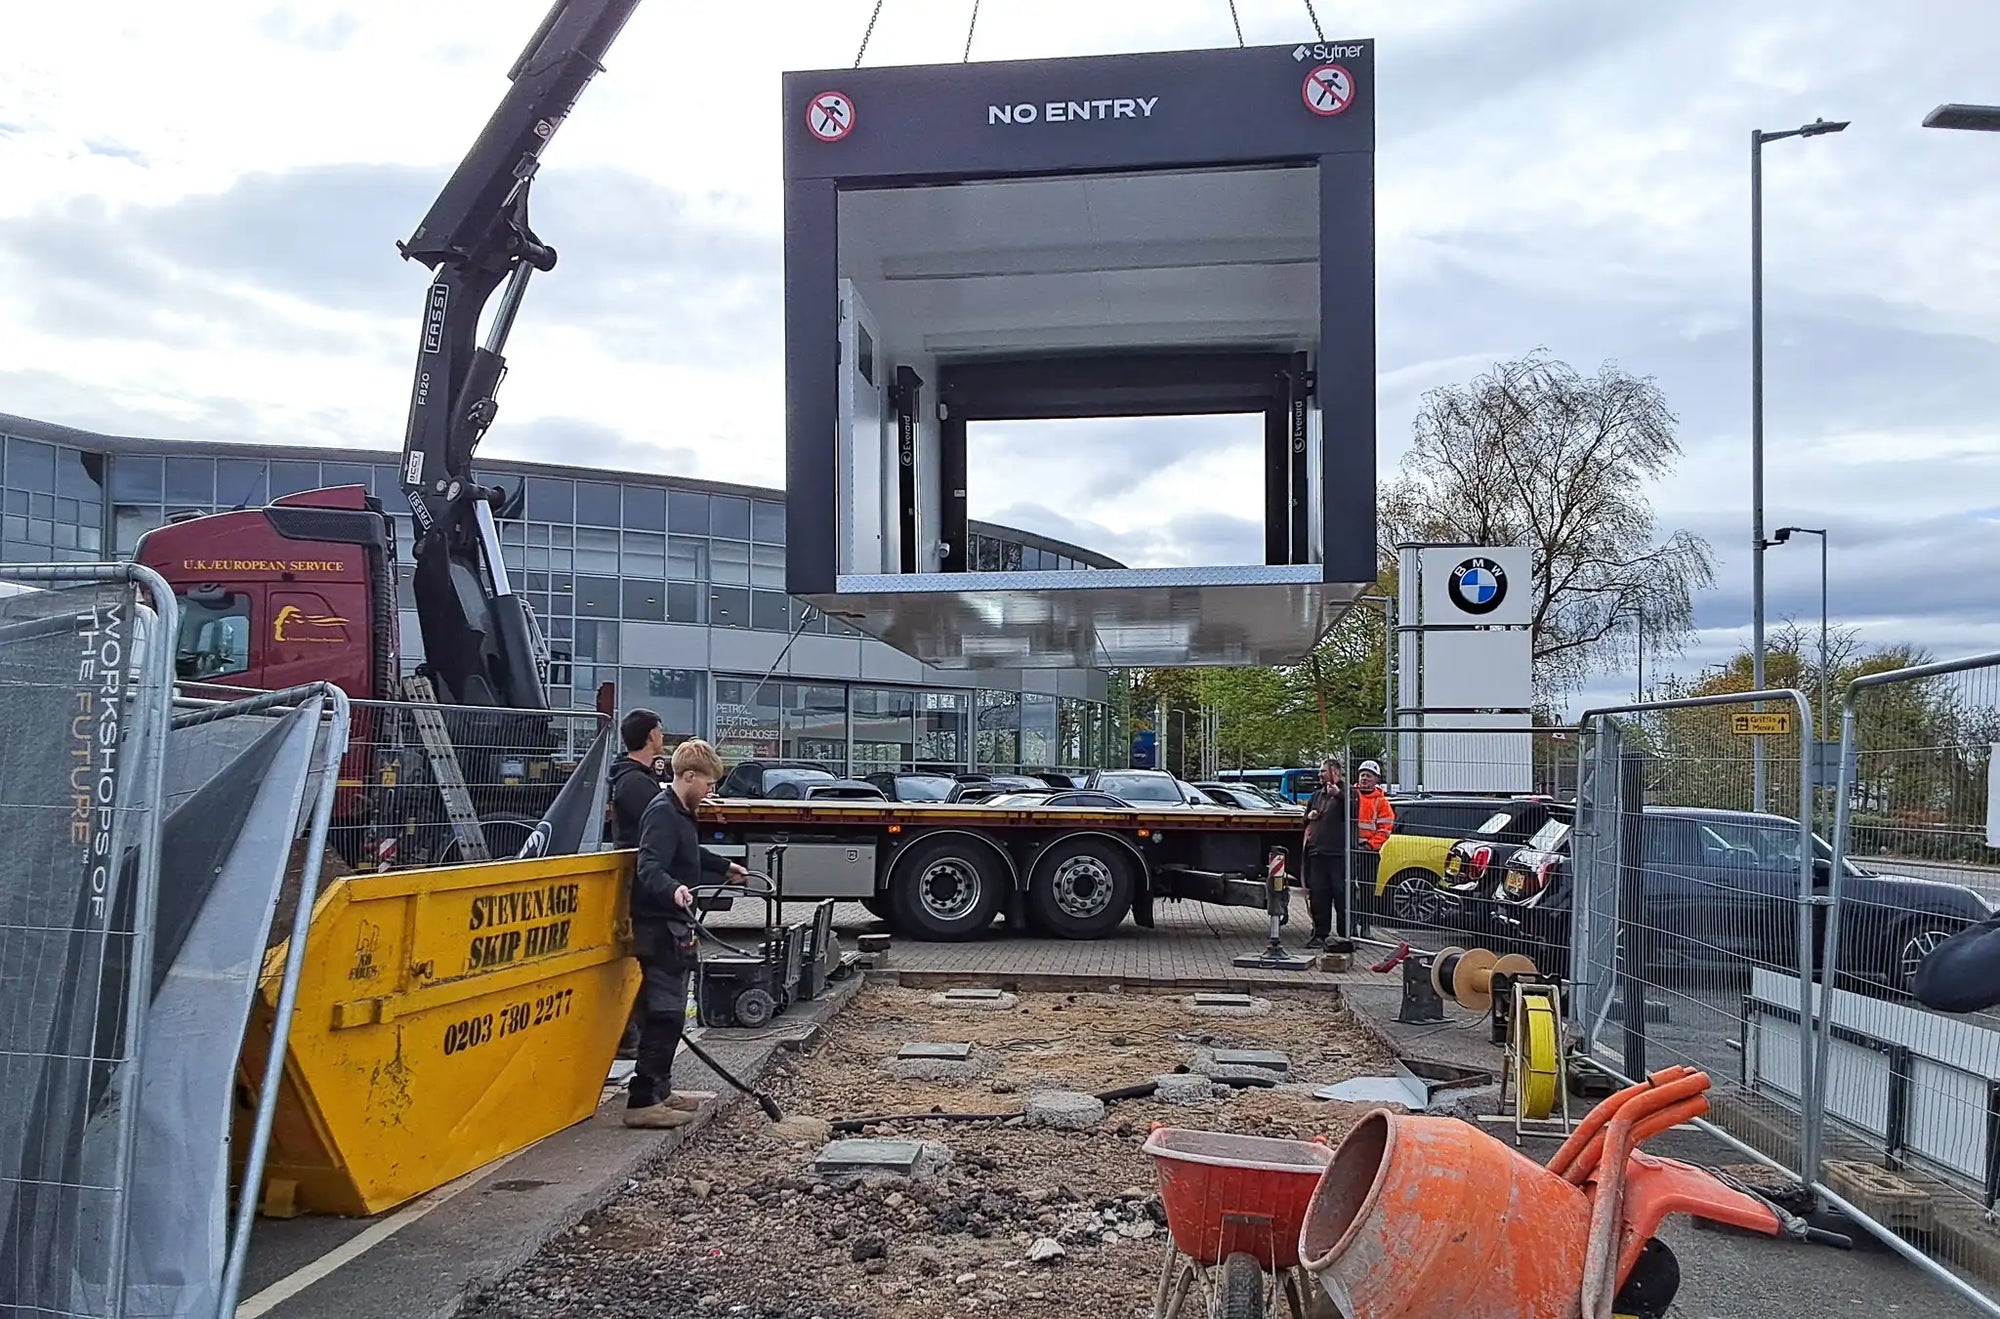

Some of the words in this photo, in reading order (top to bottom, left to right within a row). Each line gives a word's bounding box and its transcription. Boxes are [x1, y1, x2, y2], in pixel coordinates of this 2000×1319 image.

[1313, 44, 1364, 64] Sytner
[988, 103, 1038, 125] NO
[1045, 97, 1159, 122] ENTRY
[427, 289, 446, 347] FASSI
[418, 373, 430, 405] F820
[902, 415, 911, 450] Everard
[1294, 401, 1303, 437] Everard
[411, 495, 431, 526] FASSI
[289, 560, 344, 571] SERVICE
[1453, 559, 1503, 577] BMW
[77, 605, 99, 681] THE
[95, 603, 121, 856] WORKSHOPS
[91, 866, 107, 919] OF
[469, 884, 579, 931] STEVENAGE
[469, 931, 521, 969] SKIP
[523, 920, 571, 958] HIRE
[444, 1013, 493, 1055] 0203
[499, 1002, 530, 1038] 780
[533, 988, 573, 1026] 2277
